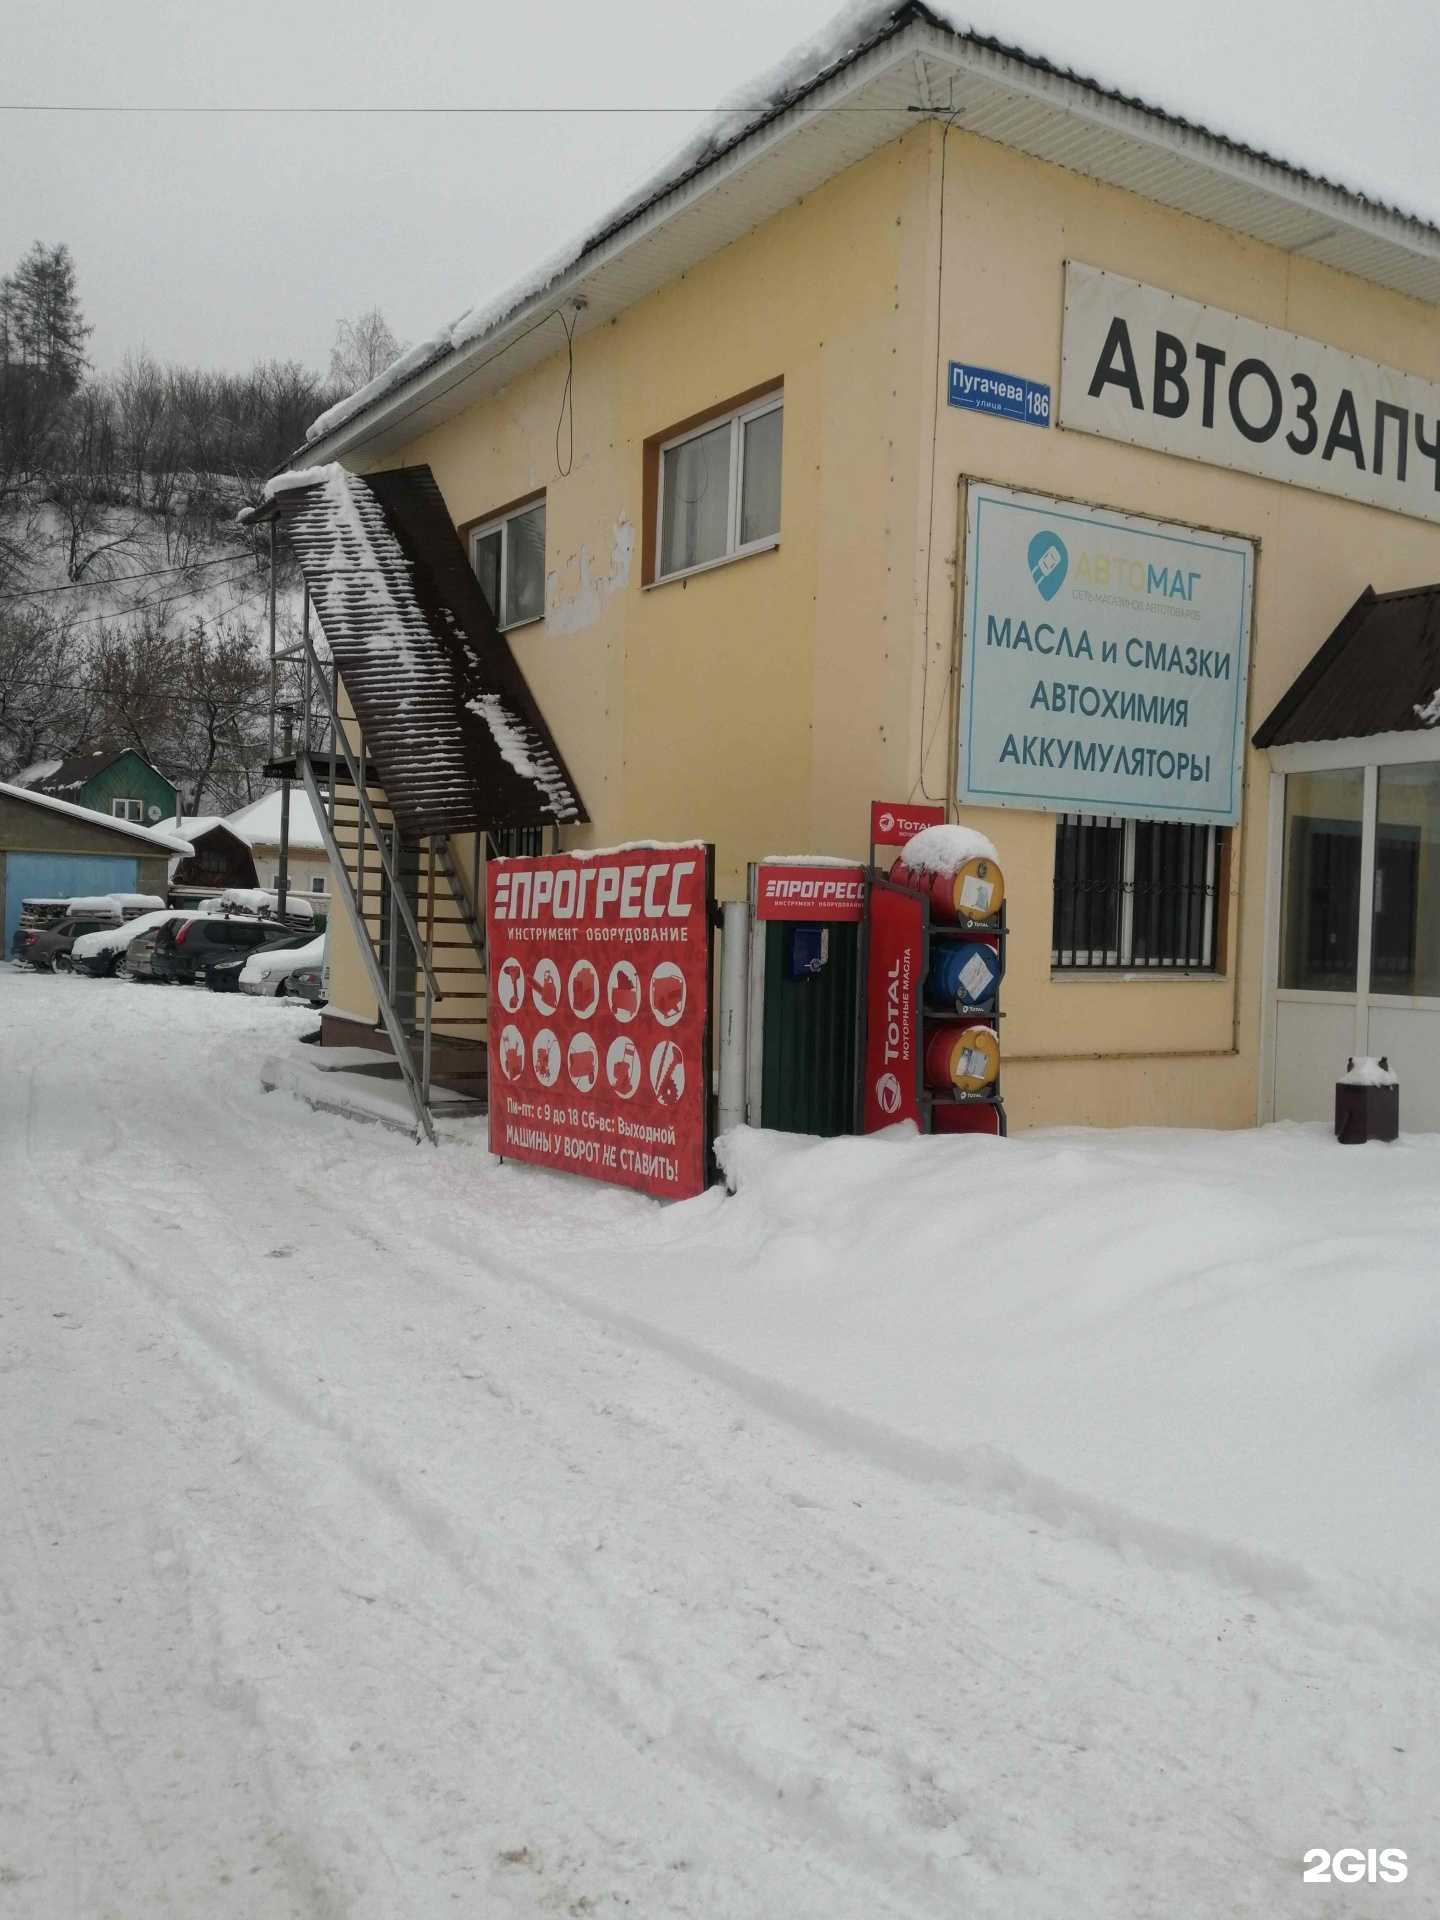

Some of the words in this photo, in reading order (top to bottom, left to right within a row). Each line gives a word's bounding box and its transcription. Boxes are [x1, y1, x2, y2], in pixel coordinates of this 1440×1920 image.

[953, 367, 1023, 401] Пугачева
[1027, 391, 1049, 417] 186
[976, 399, 1002, 411] улица
[1088, 316, 1440, 492] АВТОЗАПЧ
[1074, 551, 1202, 601] АВТОМАГ
[986, 614, 1094, 660] МАСЛА
[1101, 640, 1118, 664] и
[1125, 637, 1231, 680] СМАЗКИ
[1029, 680, 1189, 728] АВТОХИМИЯ
[998, 733, 1211, 782] АККУМУЛЯТОРЫ
[506, 861, 696, 920] ПРОГРЕСС
[507, 927, 578, 942] ИНСТРУМЕНТ
[586, 927, 688, 944] ОБОРУДОВАНИЕ
[903, 948, 912, 989] МАСЛА
[884, 959, 900, 1065] TOTAL
[902, 993, 910, 1060] МОТОРНЫЕ
[537, 1107, 542, 1120] с
[544, 1104, 550, 1120] 9
[553, 1110, 566, 1125] до
[568, 1108, 578, 1126] 18
[618, 1117, 676, 1146] Выходной
[506, 1125, 551, 1153] МАШИНЫ
[554, 1135, 562, 1154] У
[564, 1137, 600, 1164] ВОРОТ
[602, 1144, 617, 1167] НЕ
[620, 1148, 679, 1182] СТАВИТЬ!
